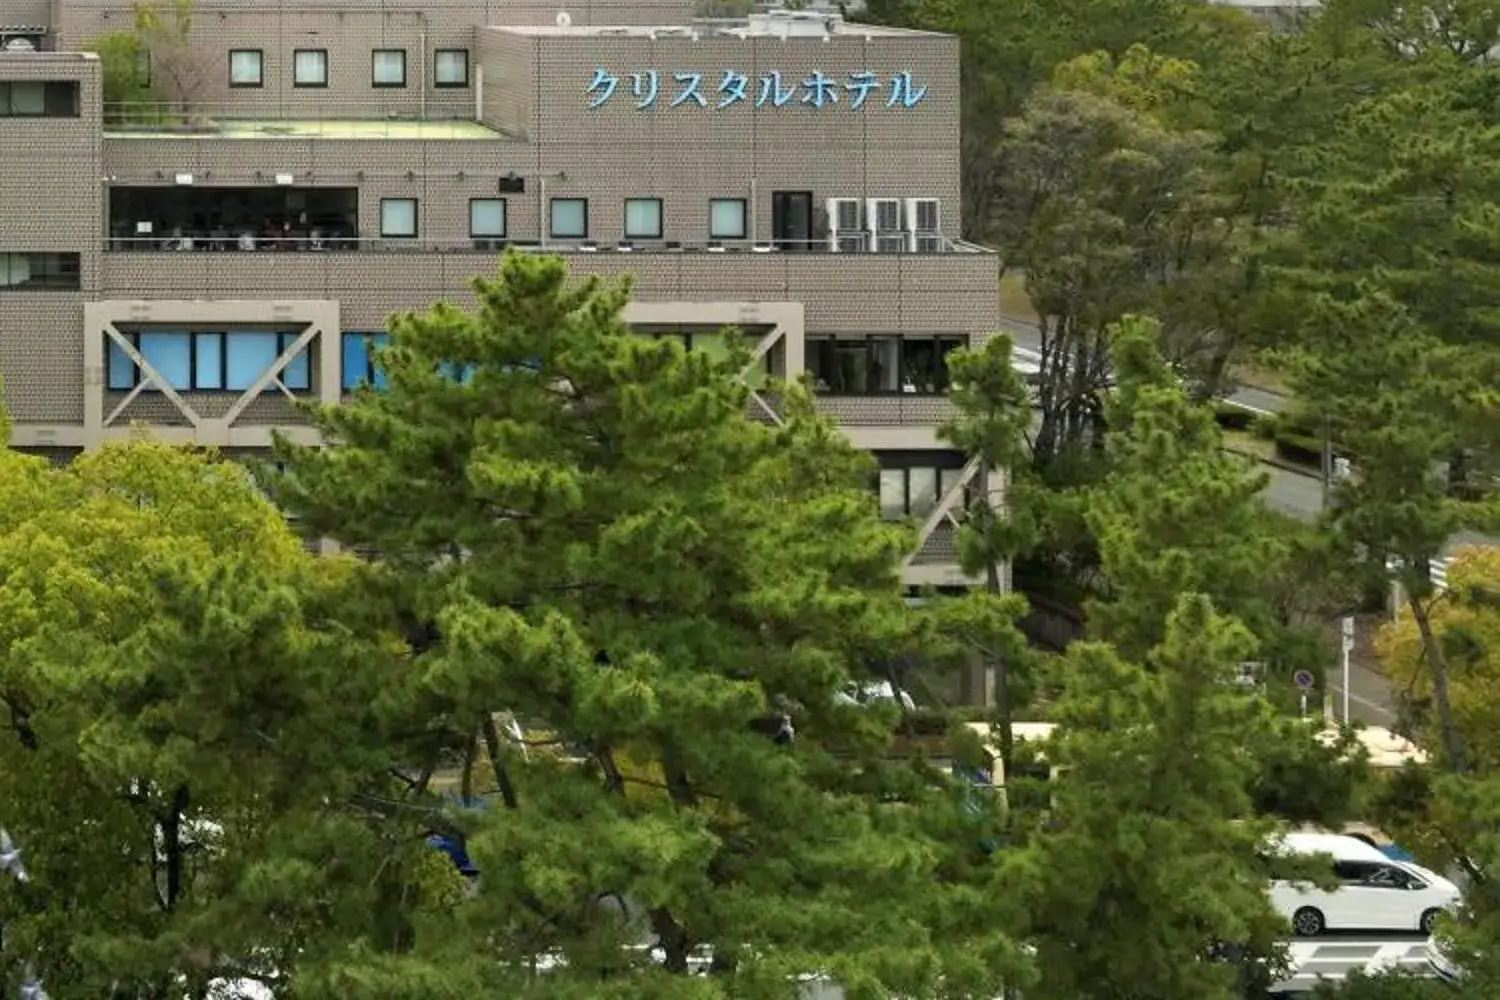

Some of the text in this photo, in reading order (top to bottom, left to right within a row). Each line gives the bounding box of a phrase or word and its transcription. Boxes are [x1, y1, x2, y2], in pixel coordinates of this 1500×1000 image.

[586, 68, 928, 109] クリスタルホテル
